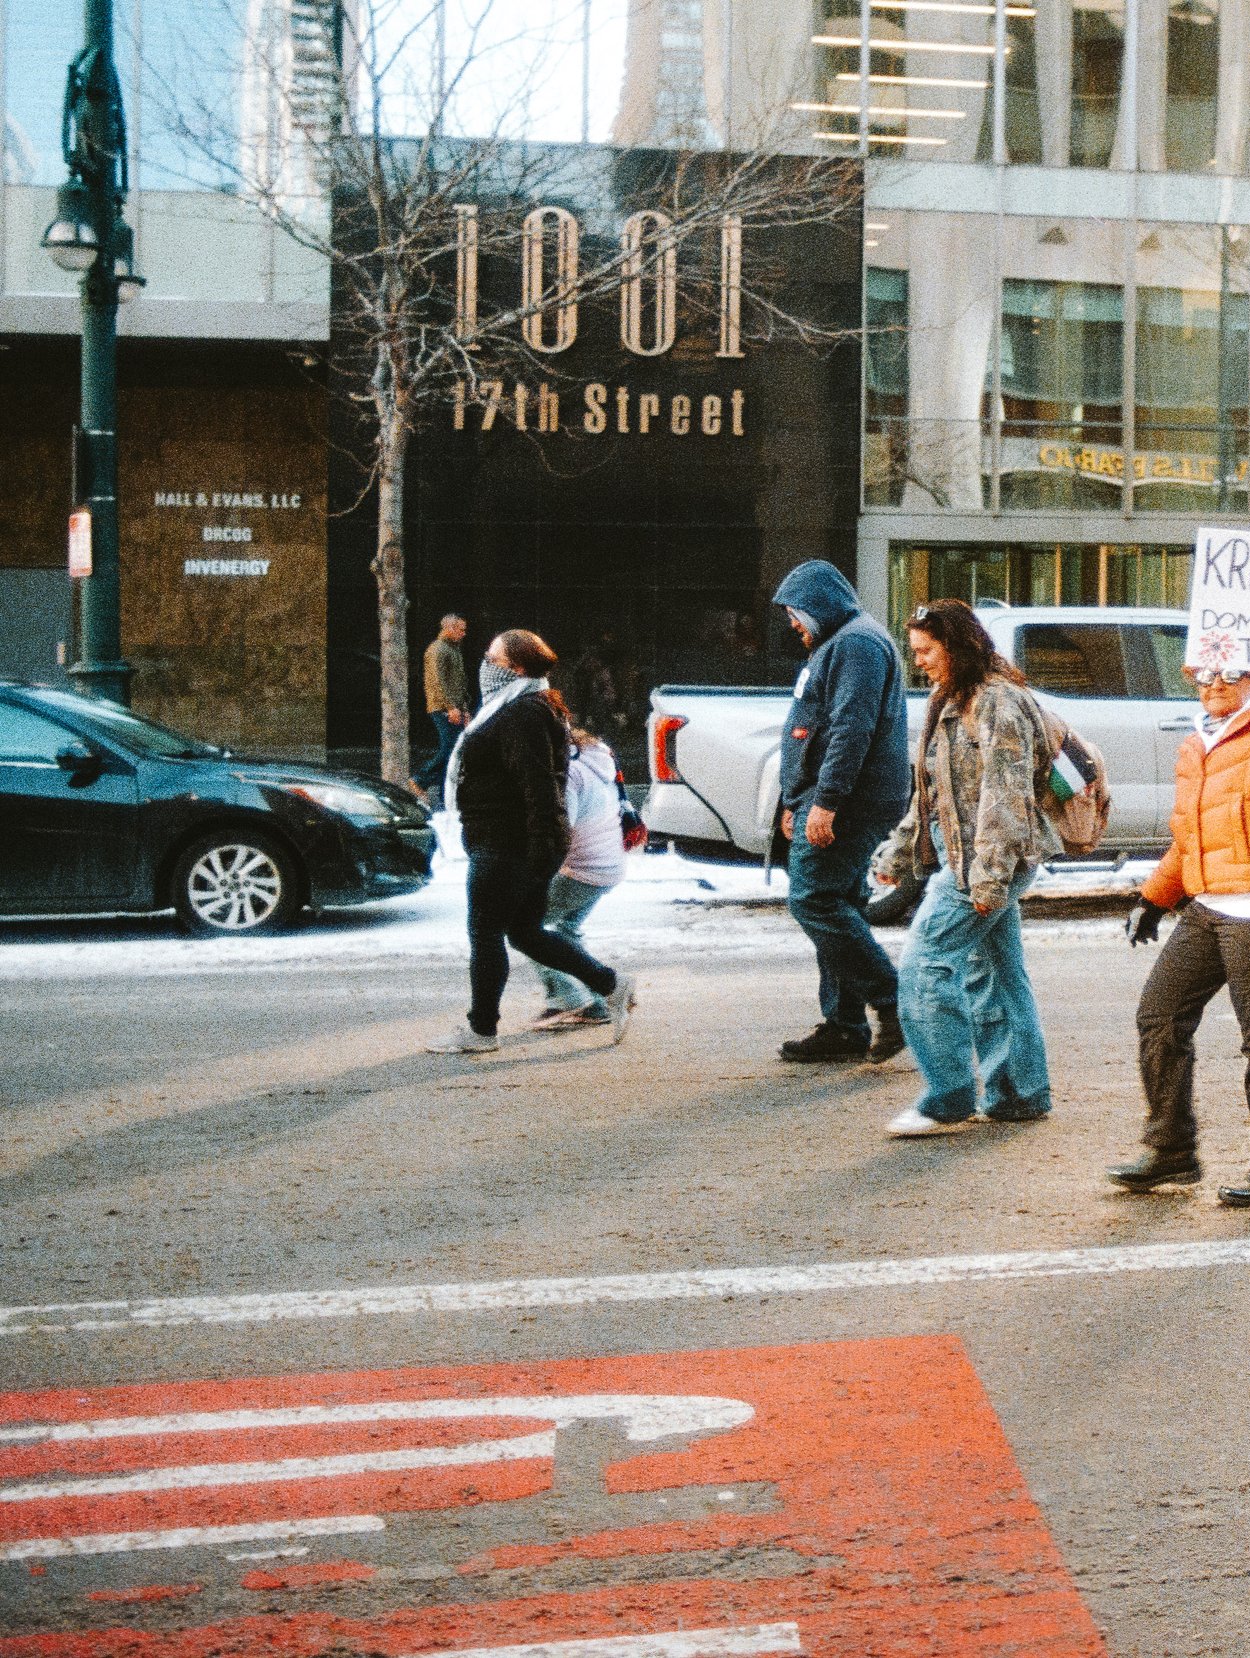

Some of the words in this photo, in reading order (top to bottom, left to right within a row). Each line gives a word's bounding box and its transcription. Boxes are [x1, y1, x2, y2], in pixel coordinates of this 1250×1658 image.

[453, 204, 746, 358] 1001
[453, 381, 559, 432] 17th
[584, 383, 745, 436] Street
[154, 492, 192, 508] HALL
[195, 492, 208, 507] &
[271, 493, 301, 509] LLC
[184, 559, 269, 576] INVENERGY
